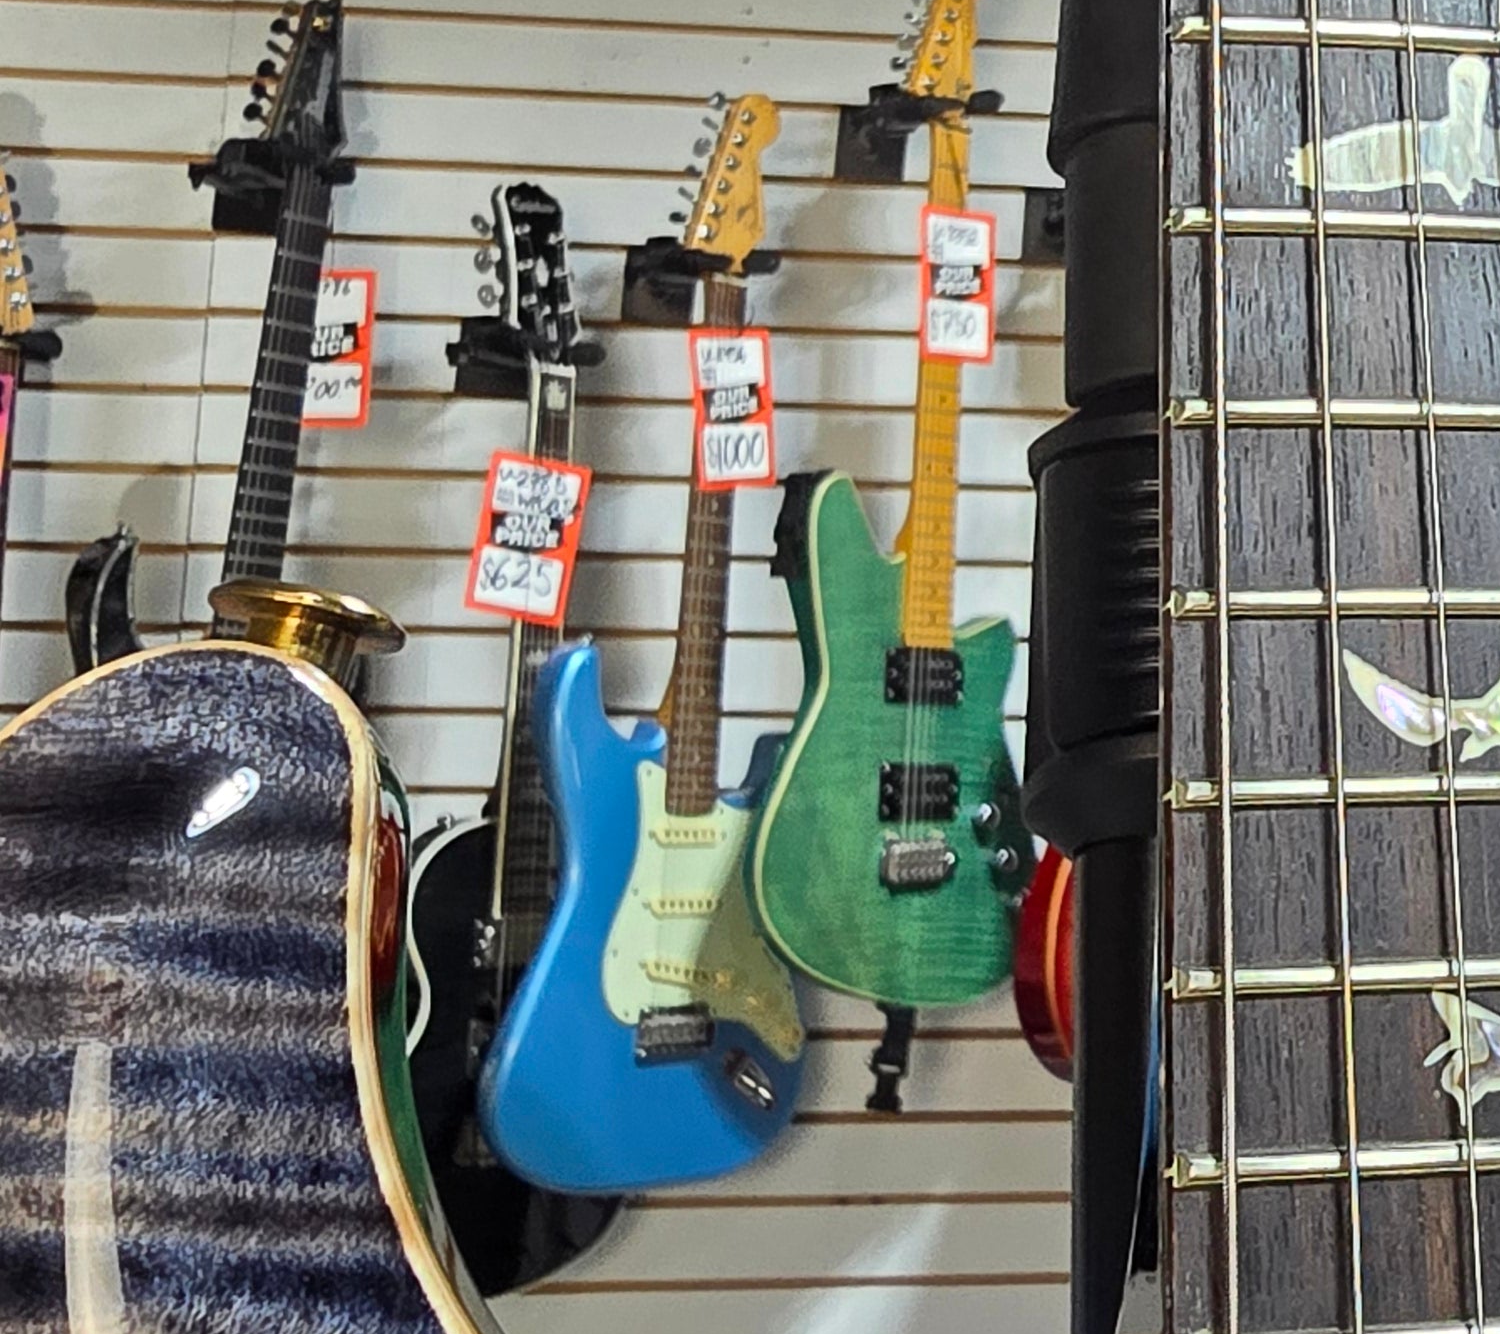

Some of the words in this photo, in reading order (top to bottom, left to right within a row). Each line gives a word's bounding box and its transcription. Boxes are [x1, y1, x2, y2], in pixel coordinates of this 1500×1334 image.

[713, 386, 750, 407] OUR
[710, 397, 759, 420] PRICE
[707, 431, 764, 474] $1000
[504, 514, 551, 533] OUR
[495, 526, 560, 549] PRICE
[479, 556, 552, 597] $625
